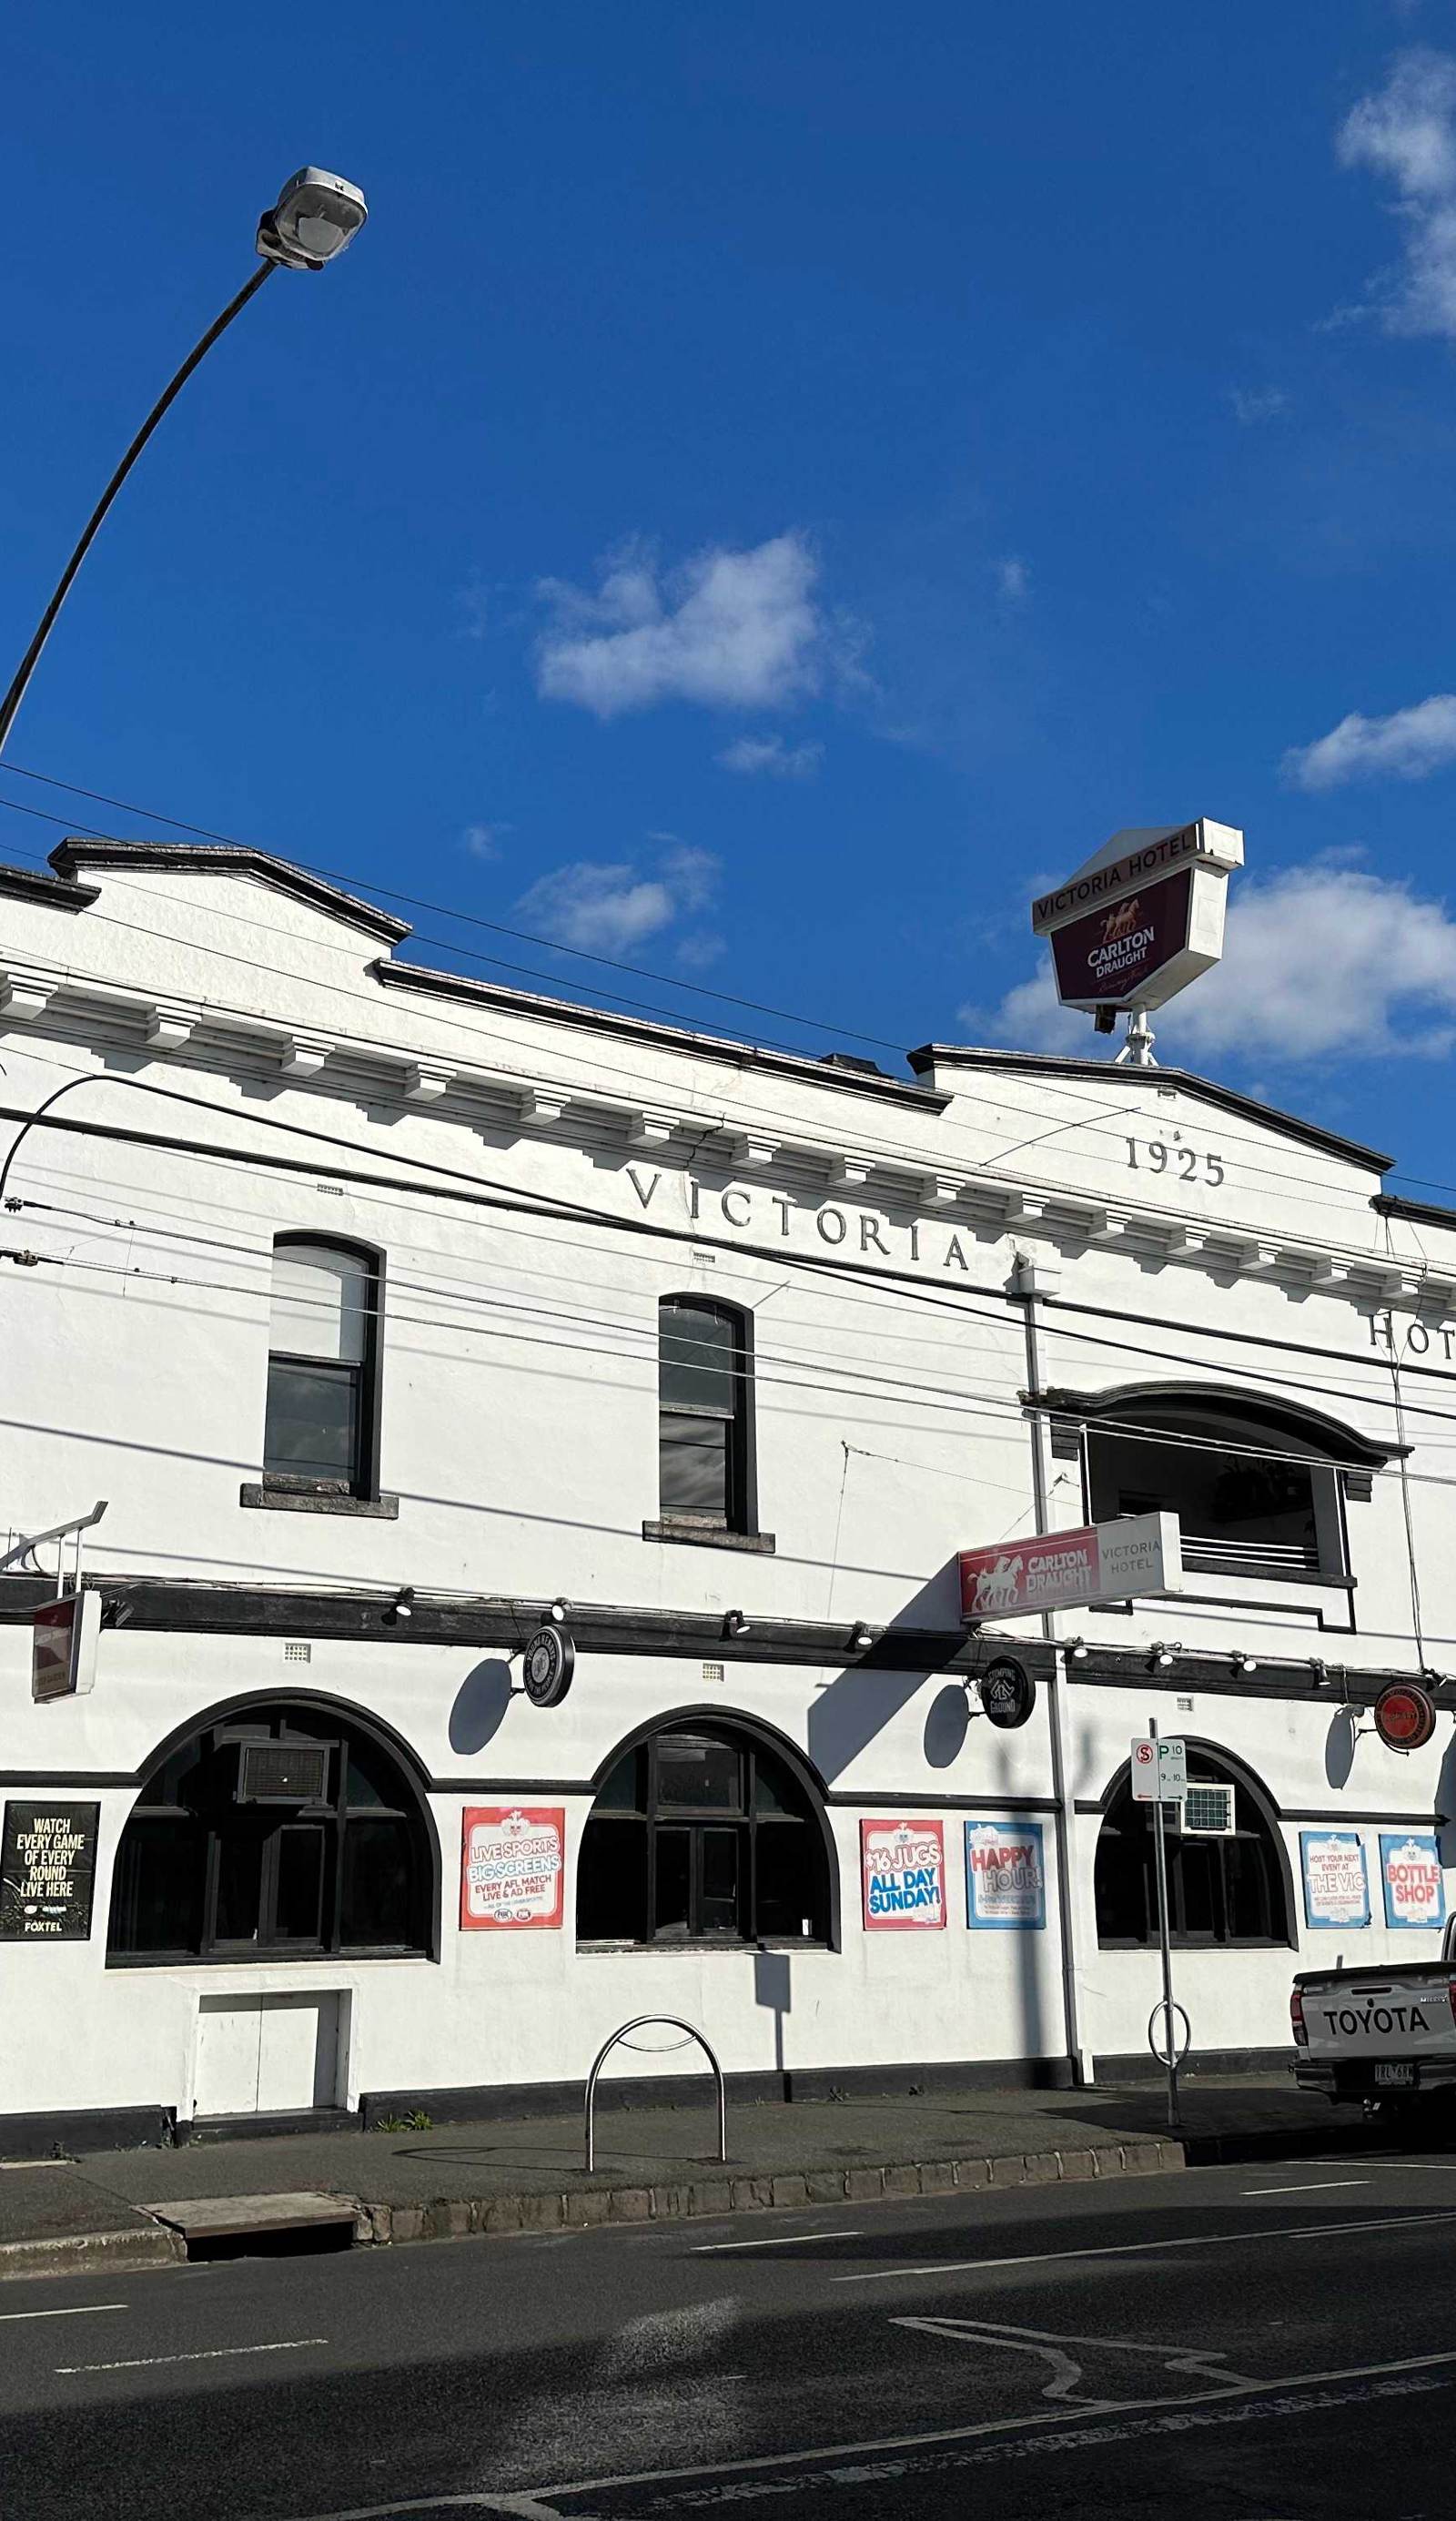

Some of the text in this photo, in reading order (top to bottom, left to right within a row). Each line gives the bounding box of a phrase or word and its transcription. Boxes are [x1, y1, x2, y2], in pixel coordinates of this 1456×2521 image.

[1038, 834, 1192, 919] VICTORIA HOTEL
[1087, 926, 1156, 968] CARLTON
[1096, 947, 1148, 979] DRAUGHT
[1126, 1137, 1225, 1188] 1925
[625, 1168, 969, 1271] VICTORIA
[1028, 1549, 1089, 1574] CARLTON
[1102, 1540, 1162, 1561] VICTORIA
[1111, 1559, 1155, 1574] HOTEL
[1026, 1565, 1092, 1593] DRAUGHT
[1159, 1745, 1169, 1760] P
[34, 1817, 71, 1834] WATCH
[16, 1834, 86, 1850] EVERY GAME
[471, 1835, 560, 1863] LIVE SPORTS
[24, 1849, 76, 1866] OF EVERY
[865, 1841, 941, 1873] $16 JUGS
[971, 1846, 1034, 1872] HAPPY
[1309, 1854, 1360, 1864] HOST YOUR NEXT
[1321, 1863, 1350, 1872] EVENT AT
[29, 1866, 67, 1881] ROUND
[468, 1854, 561, 1884] BIG SCREENS
[1387, 1864, 1441, 1884] BOTTLE
[20, 1881, 75, 1898] LIVE HERE
[475, 1875, 551, 1894] EVERY AFL MATCH
[870, 1868, 936, 1894] ALL DAY
[1309, 1871, 1366, 1894] THE VIC
[482, 1891, 501, 1902] LIVE
[511, 1888, 524, 1898] AD
[525, 1884, 546, 1895] FREE
[869, 1886, 941, 1914] SUNDAY!
[1395, 1884, 1435, 1904] SHOP
[24, 1921, 63, 1932] FOXTEL
[1323, 2006, 1431, 2036] TOYOTA
